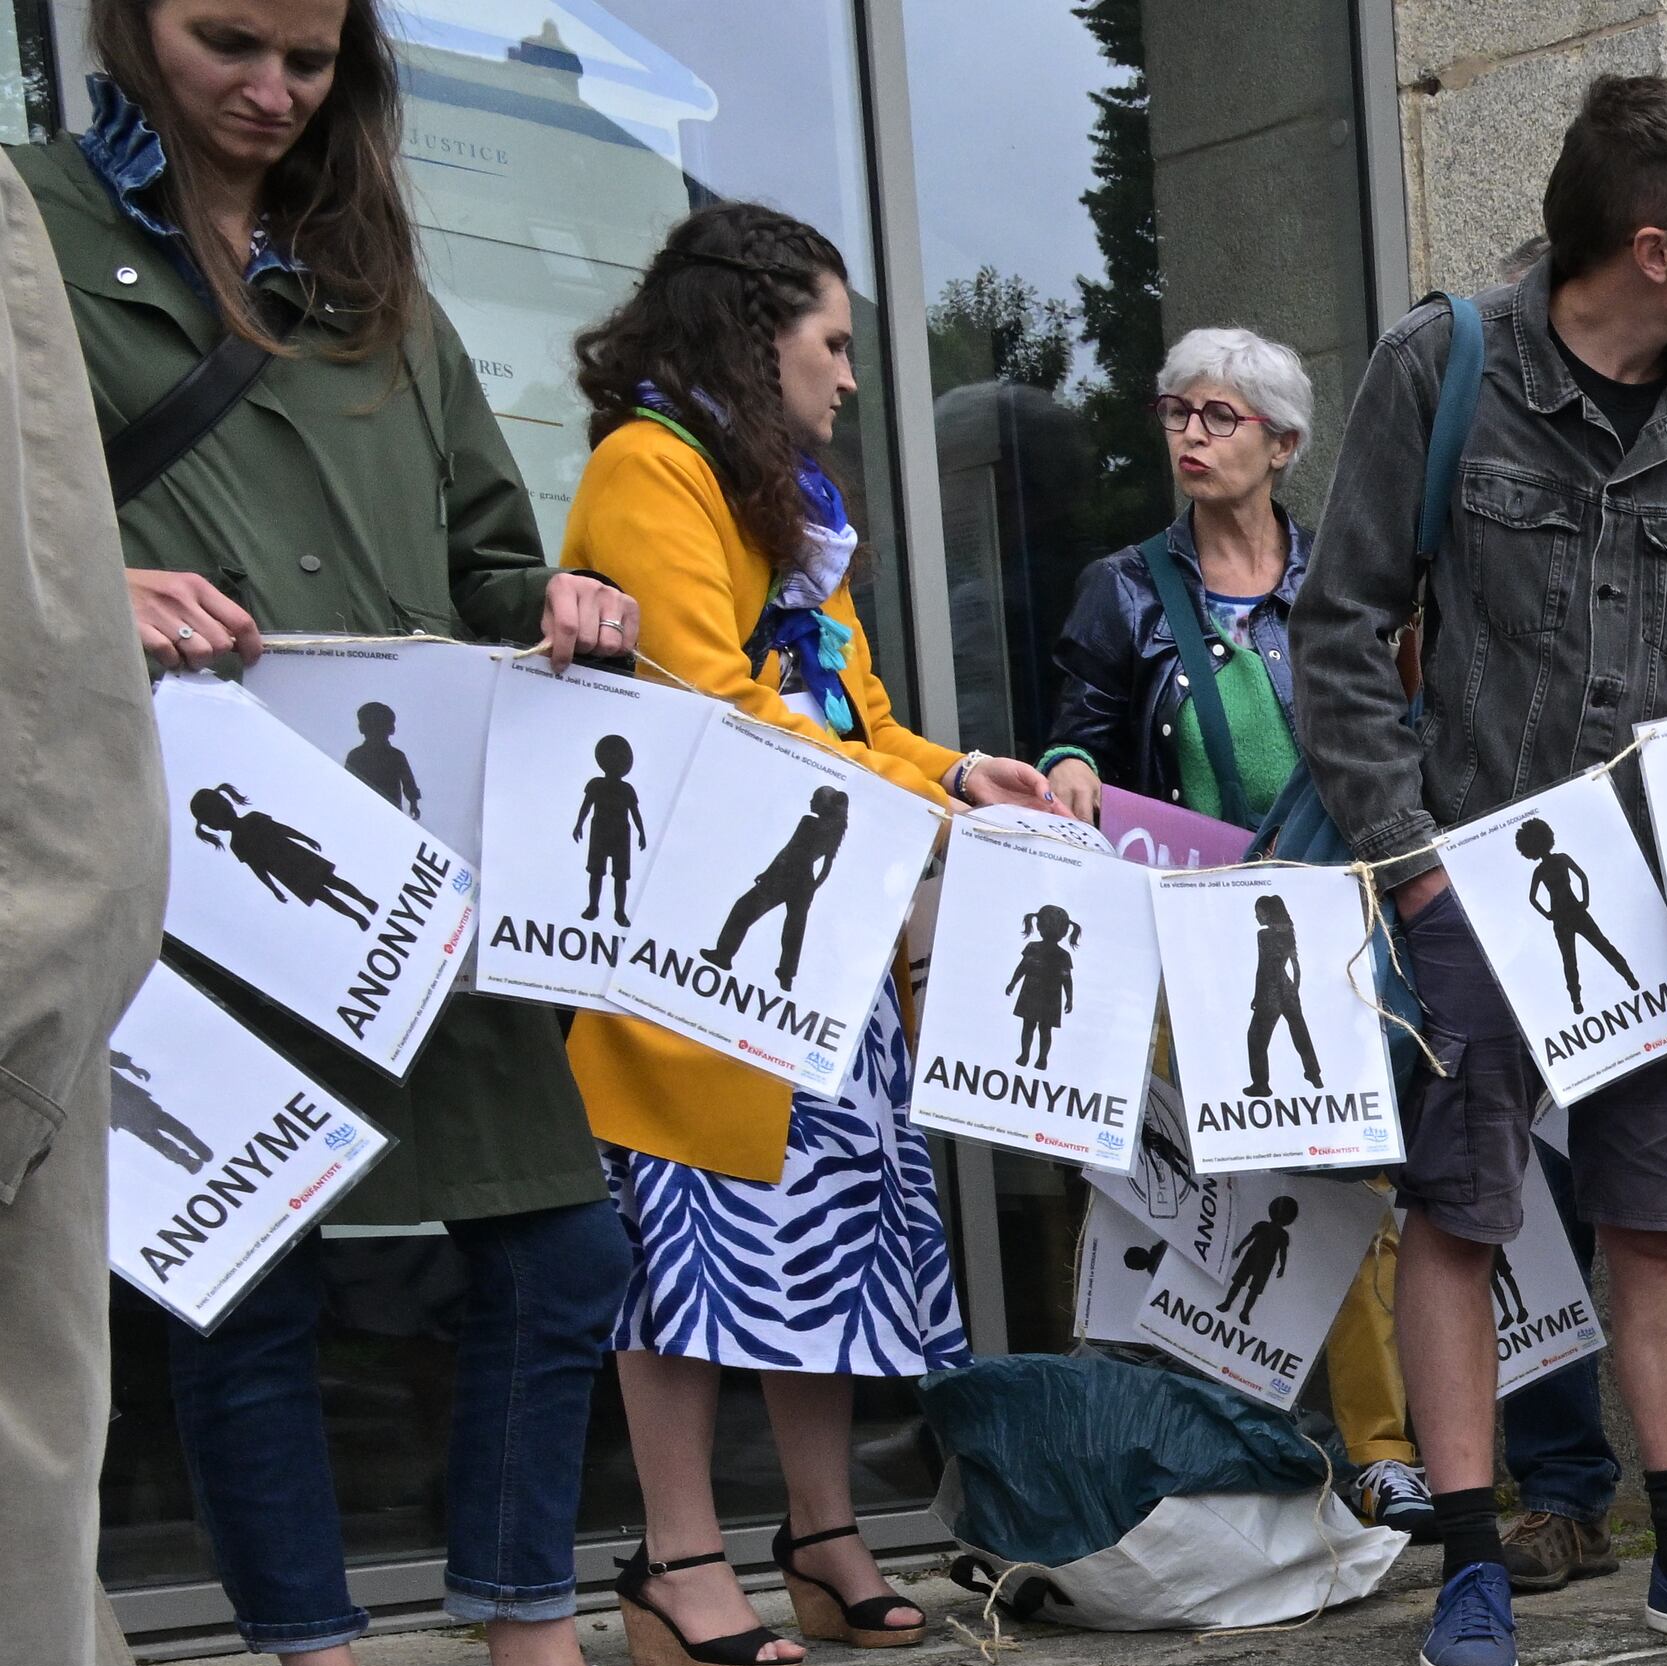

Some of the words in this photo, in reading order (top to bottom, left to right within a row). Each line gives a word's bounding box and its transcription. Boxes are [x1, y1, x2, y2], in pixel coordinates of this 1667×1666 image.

[512, 662, 524, 671] Les
[336, 840, 451, 1042] ANONYME
[490, 915, 626, 968] ANON
[629, 938, 847, 1052] ANONYME
[747, 1047, 796, 1071] ENFANTISTE
[923, 1056, 1128, 1128] ANONYME
[1197, 1092, 1383, 1133] ANONYME
[1044, 1138, 1089, 1153] ENFANTISTE
[1318, 1147, 1360, 1156] ENFANTISTE
[138, 1091, 333, 1285] ANONYME
[302, 1162, 342, 1203] ENFANTISTE
[1150, 1288, 1303, 1379] ANONYME
